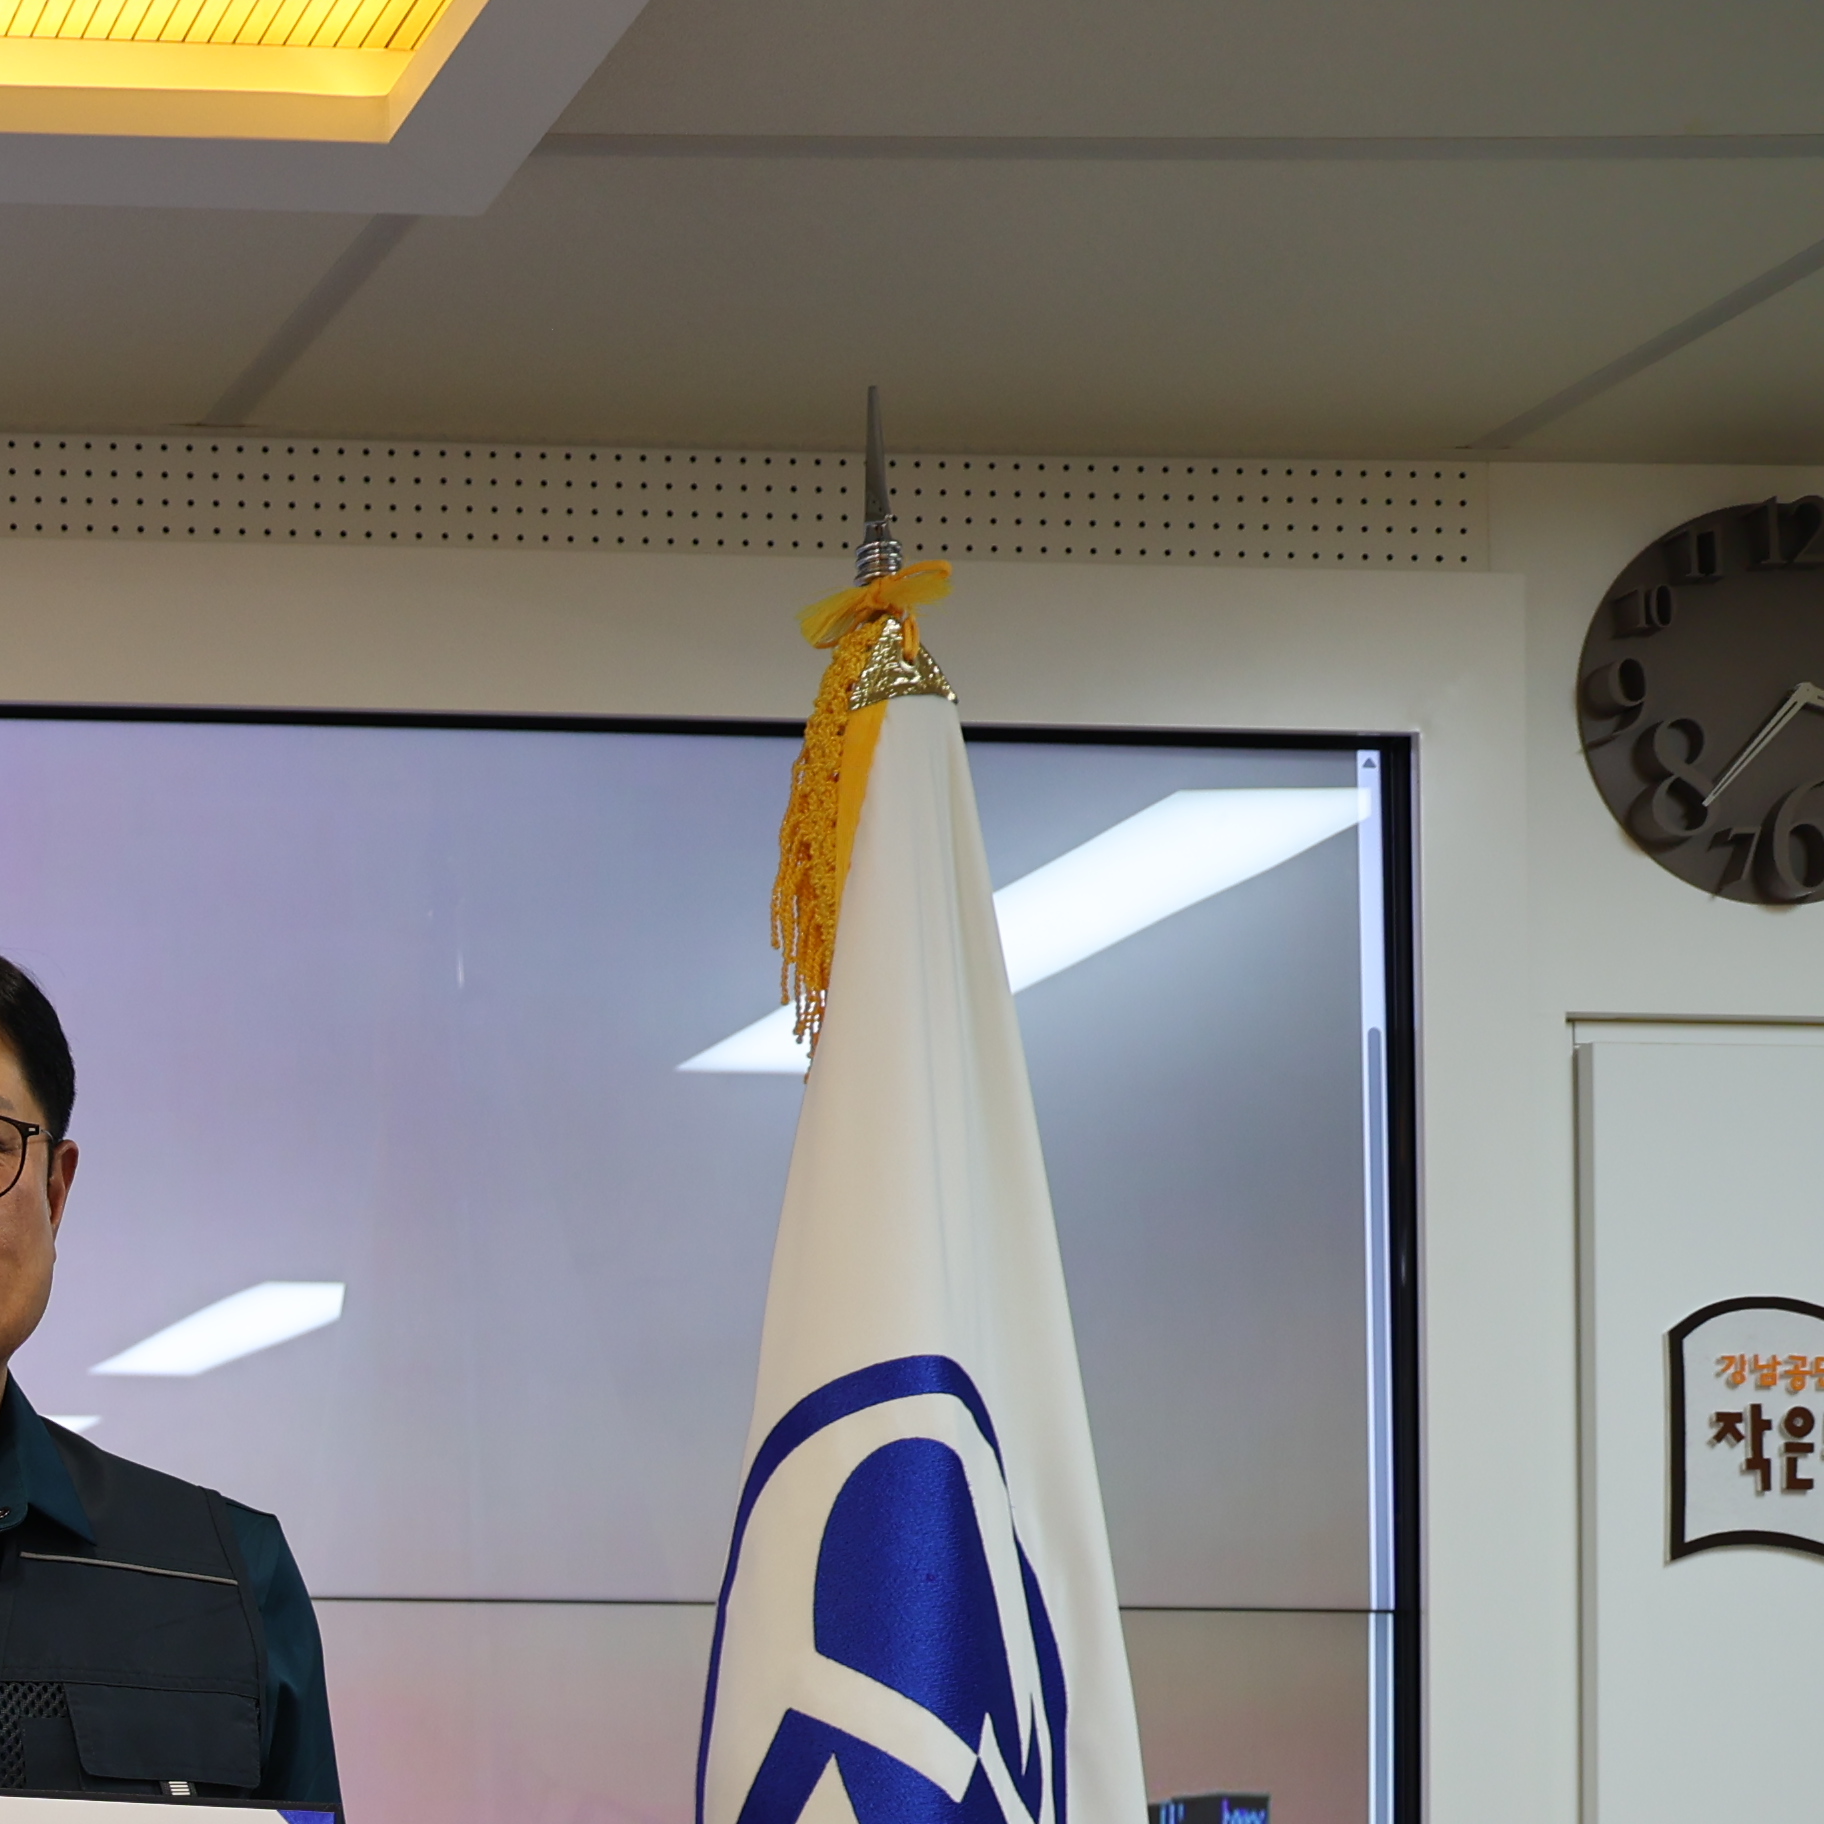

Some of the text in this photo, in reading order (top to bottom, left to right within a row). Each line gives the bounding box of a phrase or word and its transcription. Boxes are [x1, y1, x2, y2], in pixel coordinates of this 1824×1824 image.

[1677, 523, 1725, 580] 11
[1620, 584, 1673, 632] 10
[1650, 718, 1720, 838] 8
